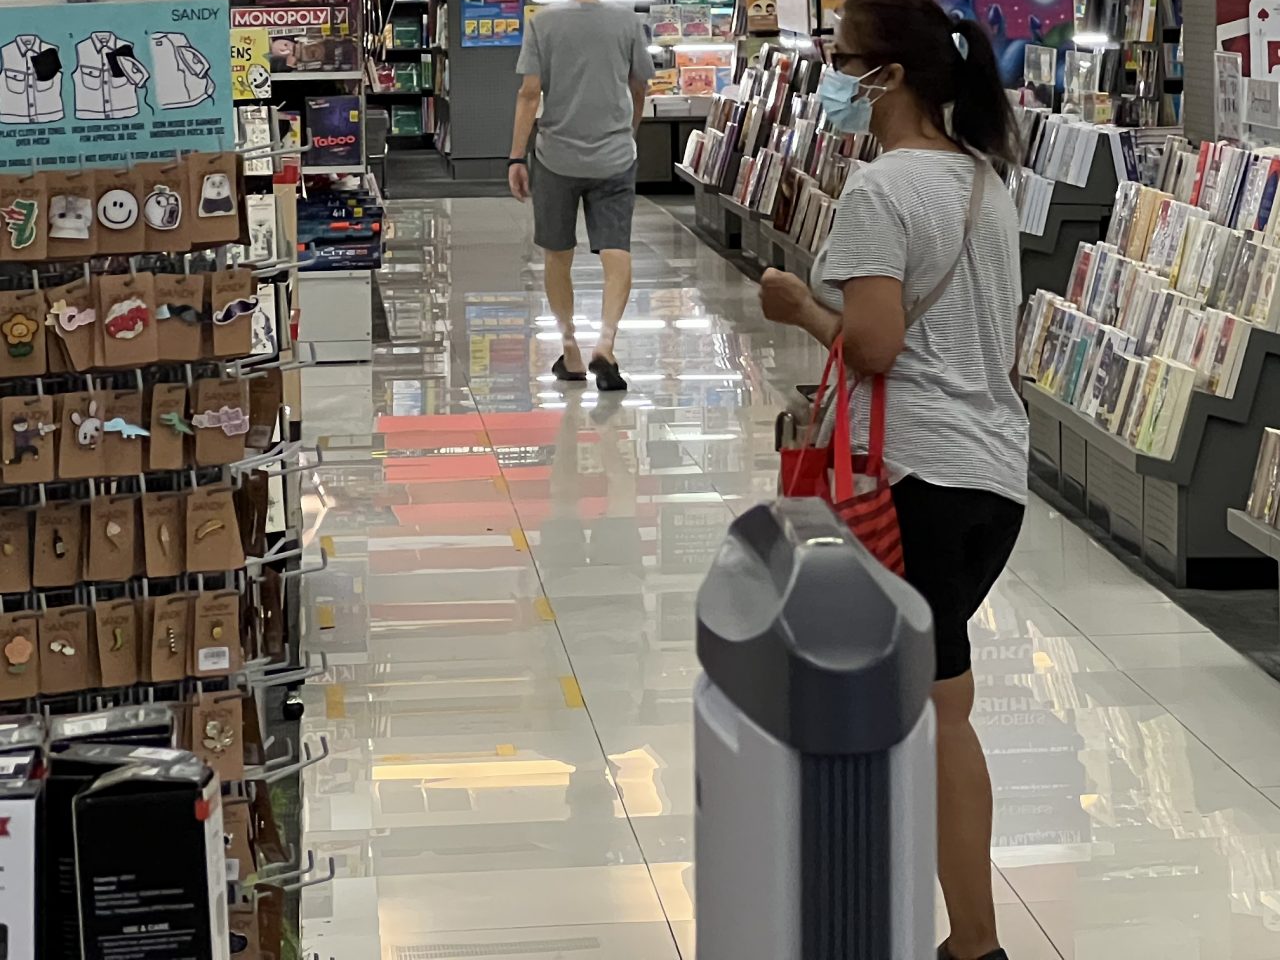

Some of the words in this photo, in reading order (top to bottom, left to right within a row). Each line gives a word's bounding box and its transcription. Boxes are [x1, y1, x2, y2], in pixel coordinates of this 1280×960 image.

[172, 7, 220, 23] SANDY
[234, 9, 330, 27] MONOPOLY
[312, 135, 356, 148] Taboo
